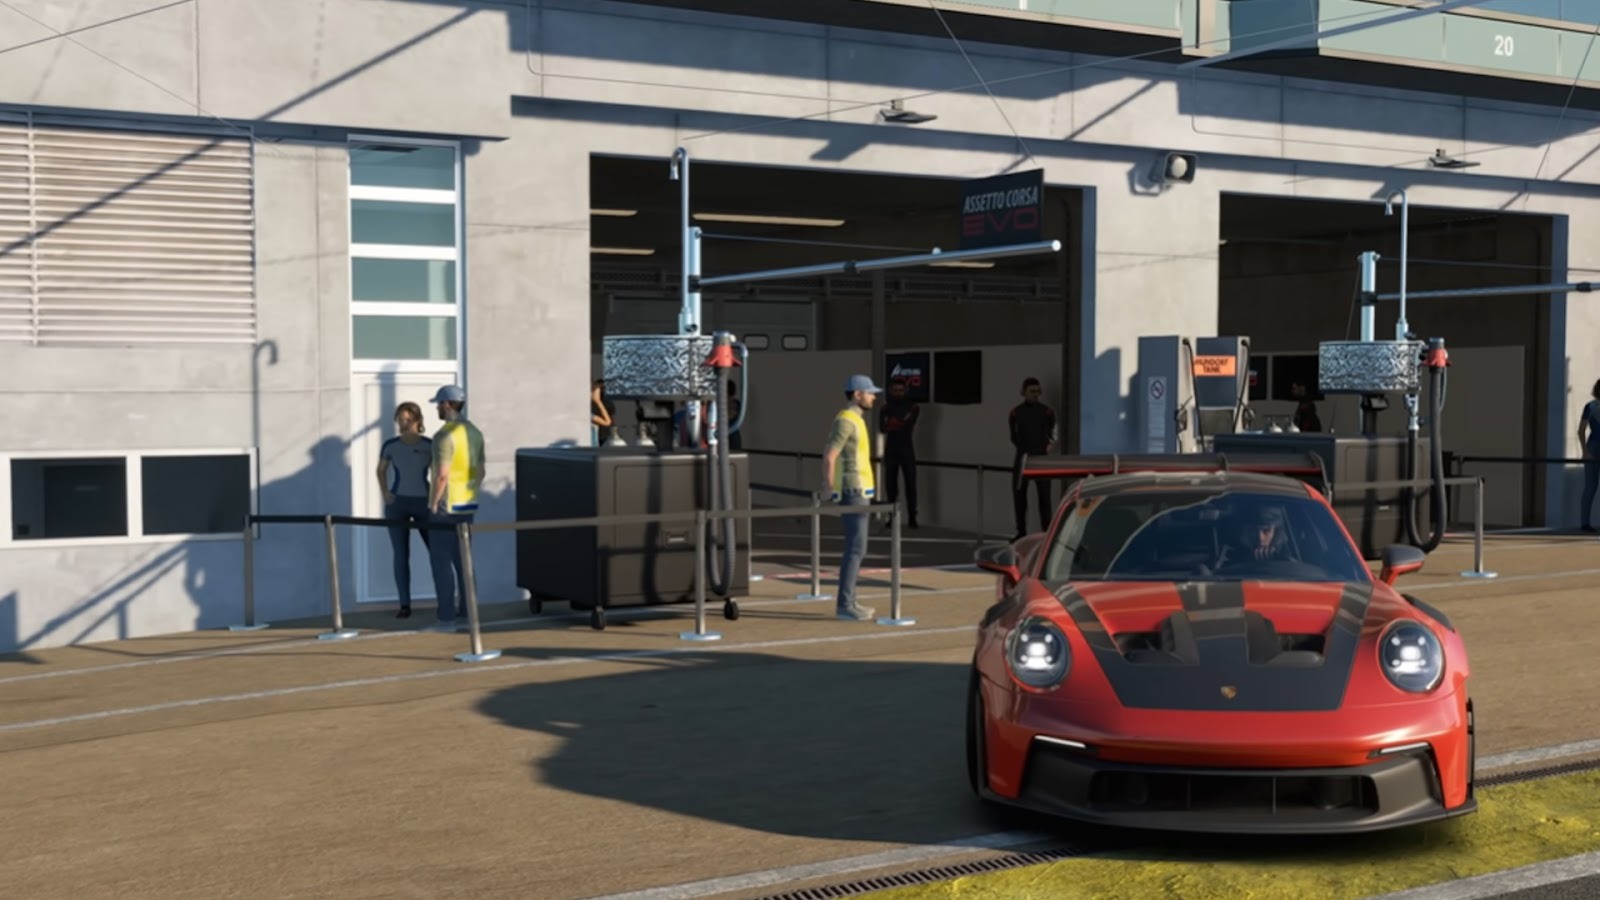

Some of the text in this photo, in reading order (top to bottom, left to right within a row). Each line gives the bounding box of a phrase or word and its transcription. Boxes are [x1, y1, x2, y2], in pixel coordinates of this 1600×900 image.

[1494, 34, 1514, 56] 20
[963, 186, 1038, 214] ASSETTO CORSA
[963, 207, 1039, 236] EVO
